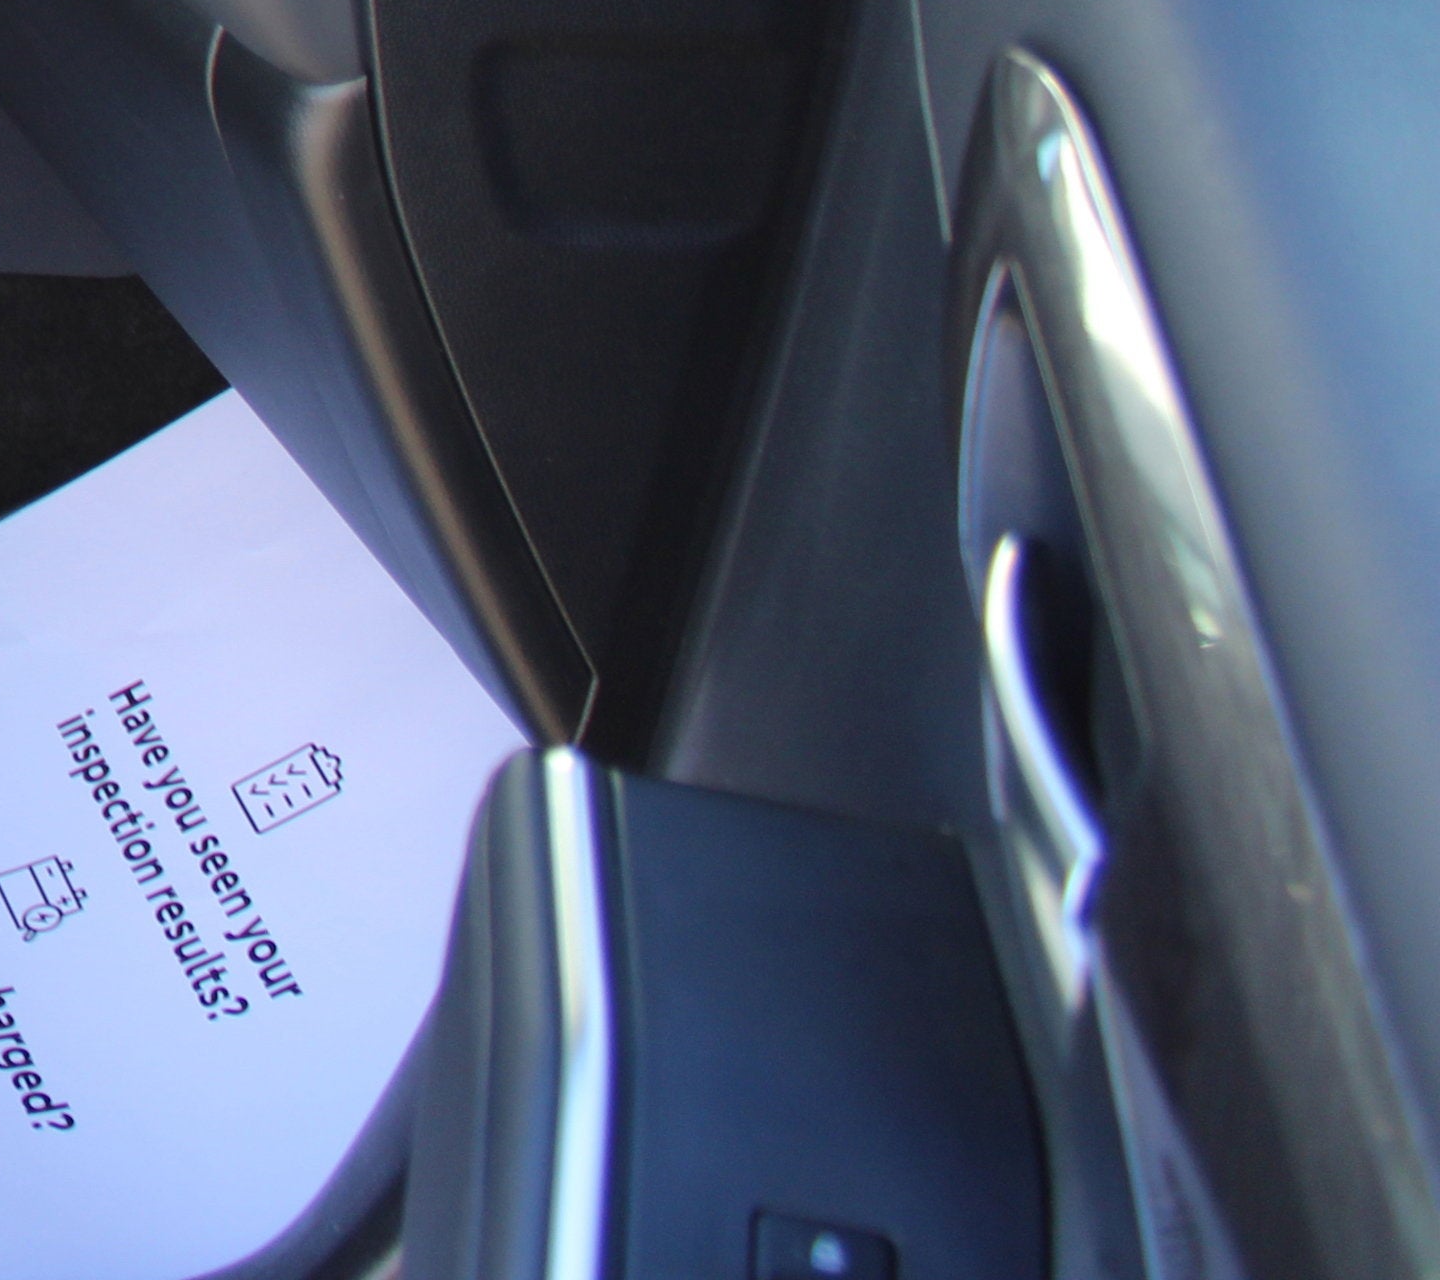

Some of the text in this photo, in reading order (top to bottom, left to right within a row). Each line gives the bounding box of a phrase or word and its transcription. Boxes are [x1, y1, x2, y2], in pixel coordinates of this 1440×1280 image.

[60, 709, 249, 1021] inspection results?
[109, 679, 303, 999] Have you seen your
